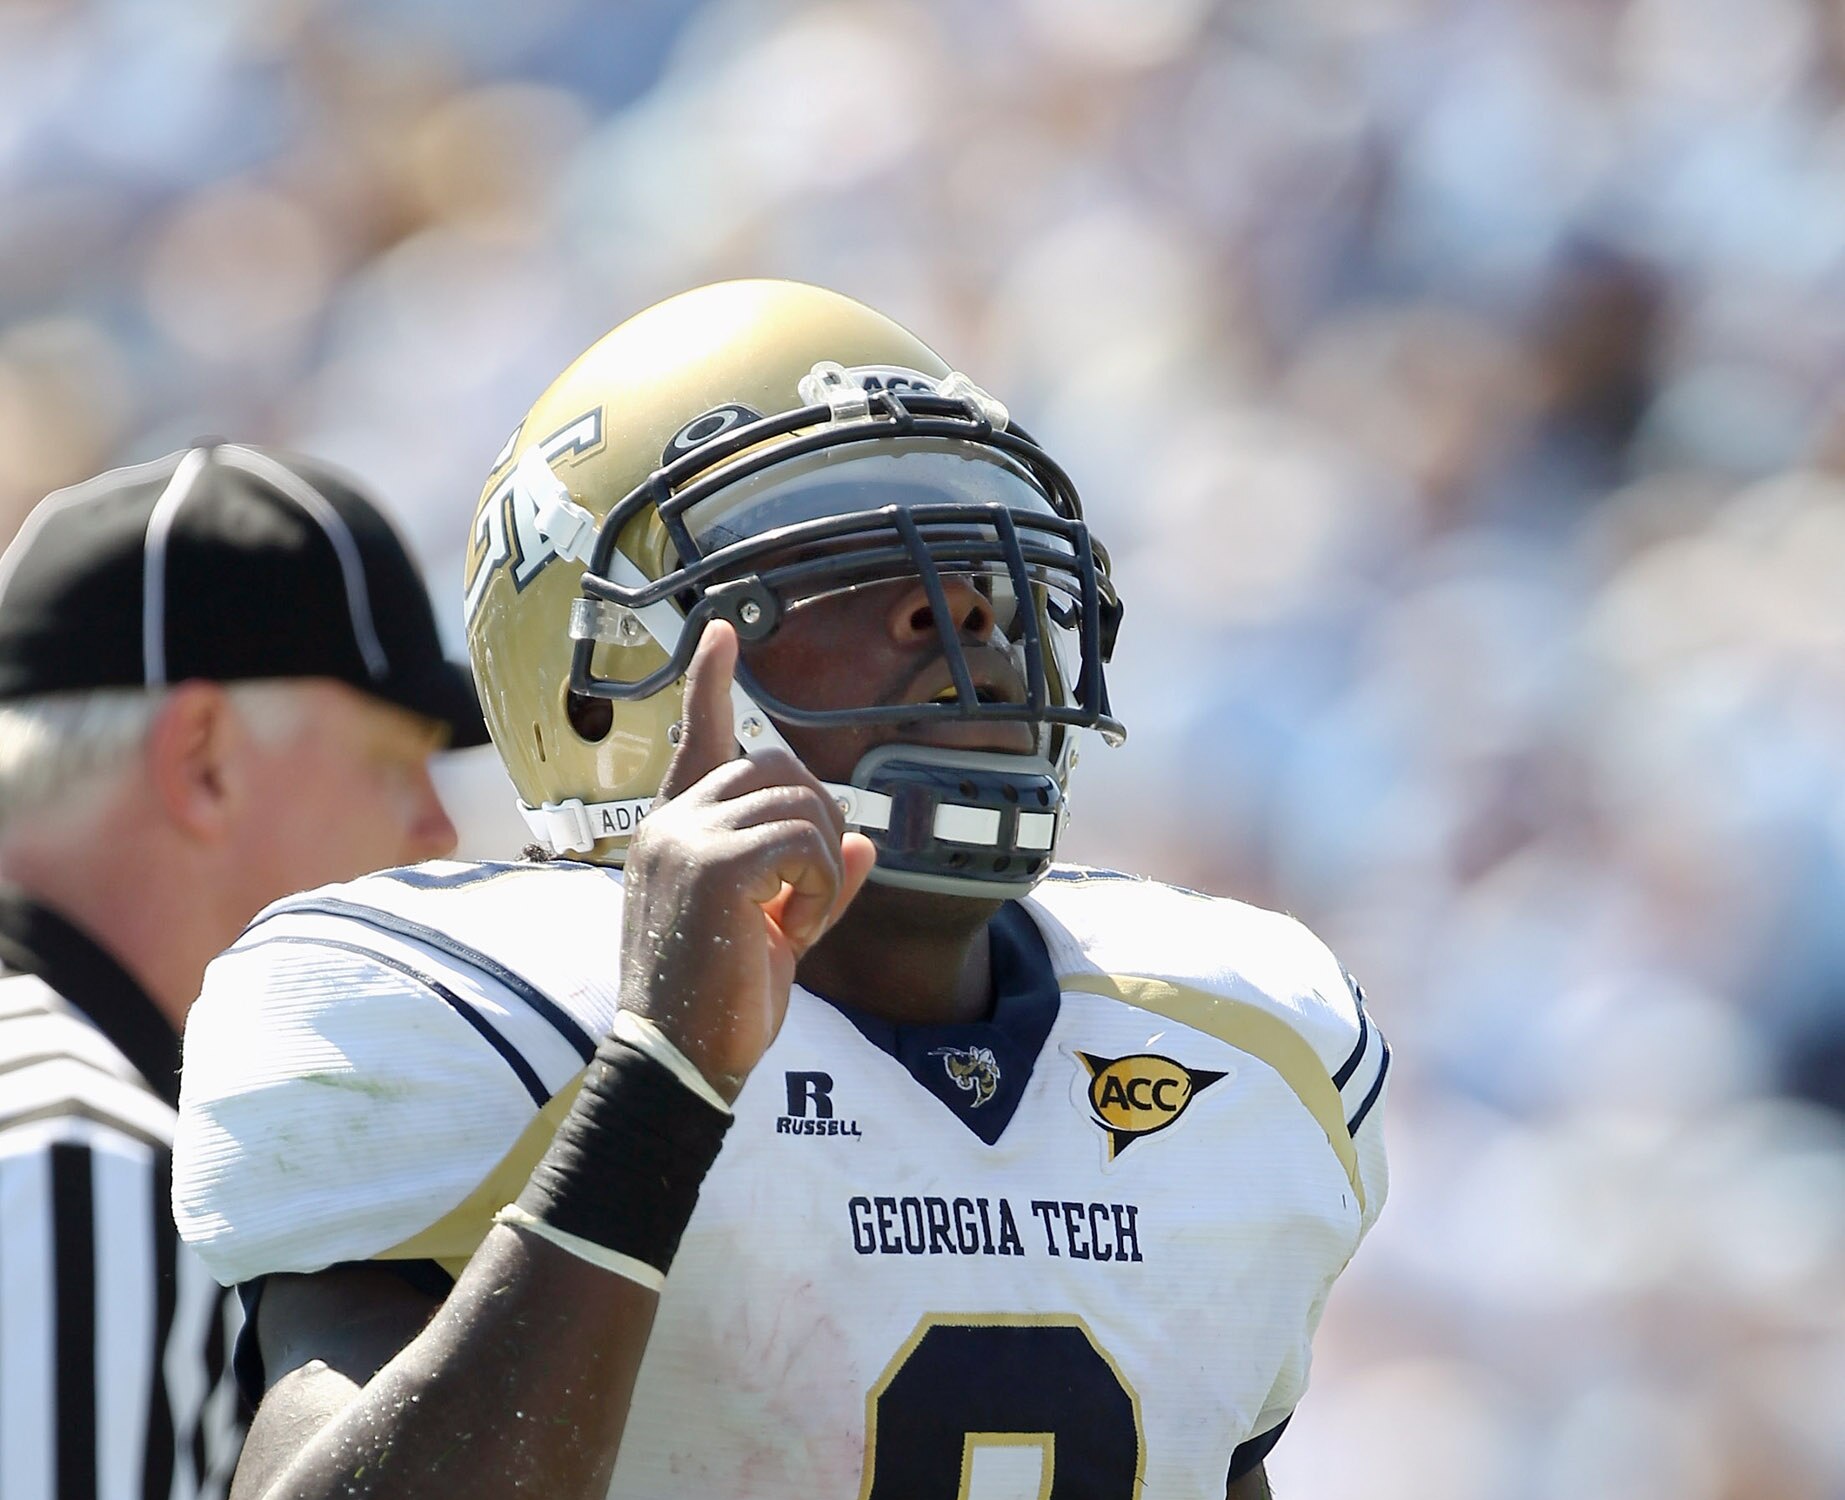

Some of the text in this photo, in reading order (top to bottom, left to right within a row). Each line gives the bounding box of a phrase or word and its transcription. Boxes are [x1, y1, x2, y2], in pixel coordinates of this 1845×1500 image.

[602, 804, 653, 833] ADA
[1099, 1075, 1179, 1112] ACC
[776, 1116, 863, 1136] RUSSELL
[848, 1196, 1143, 1262] GEORGIA TECH
